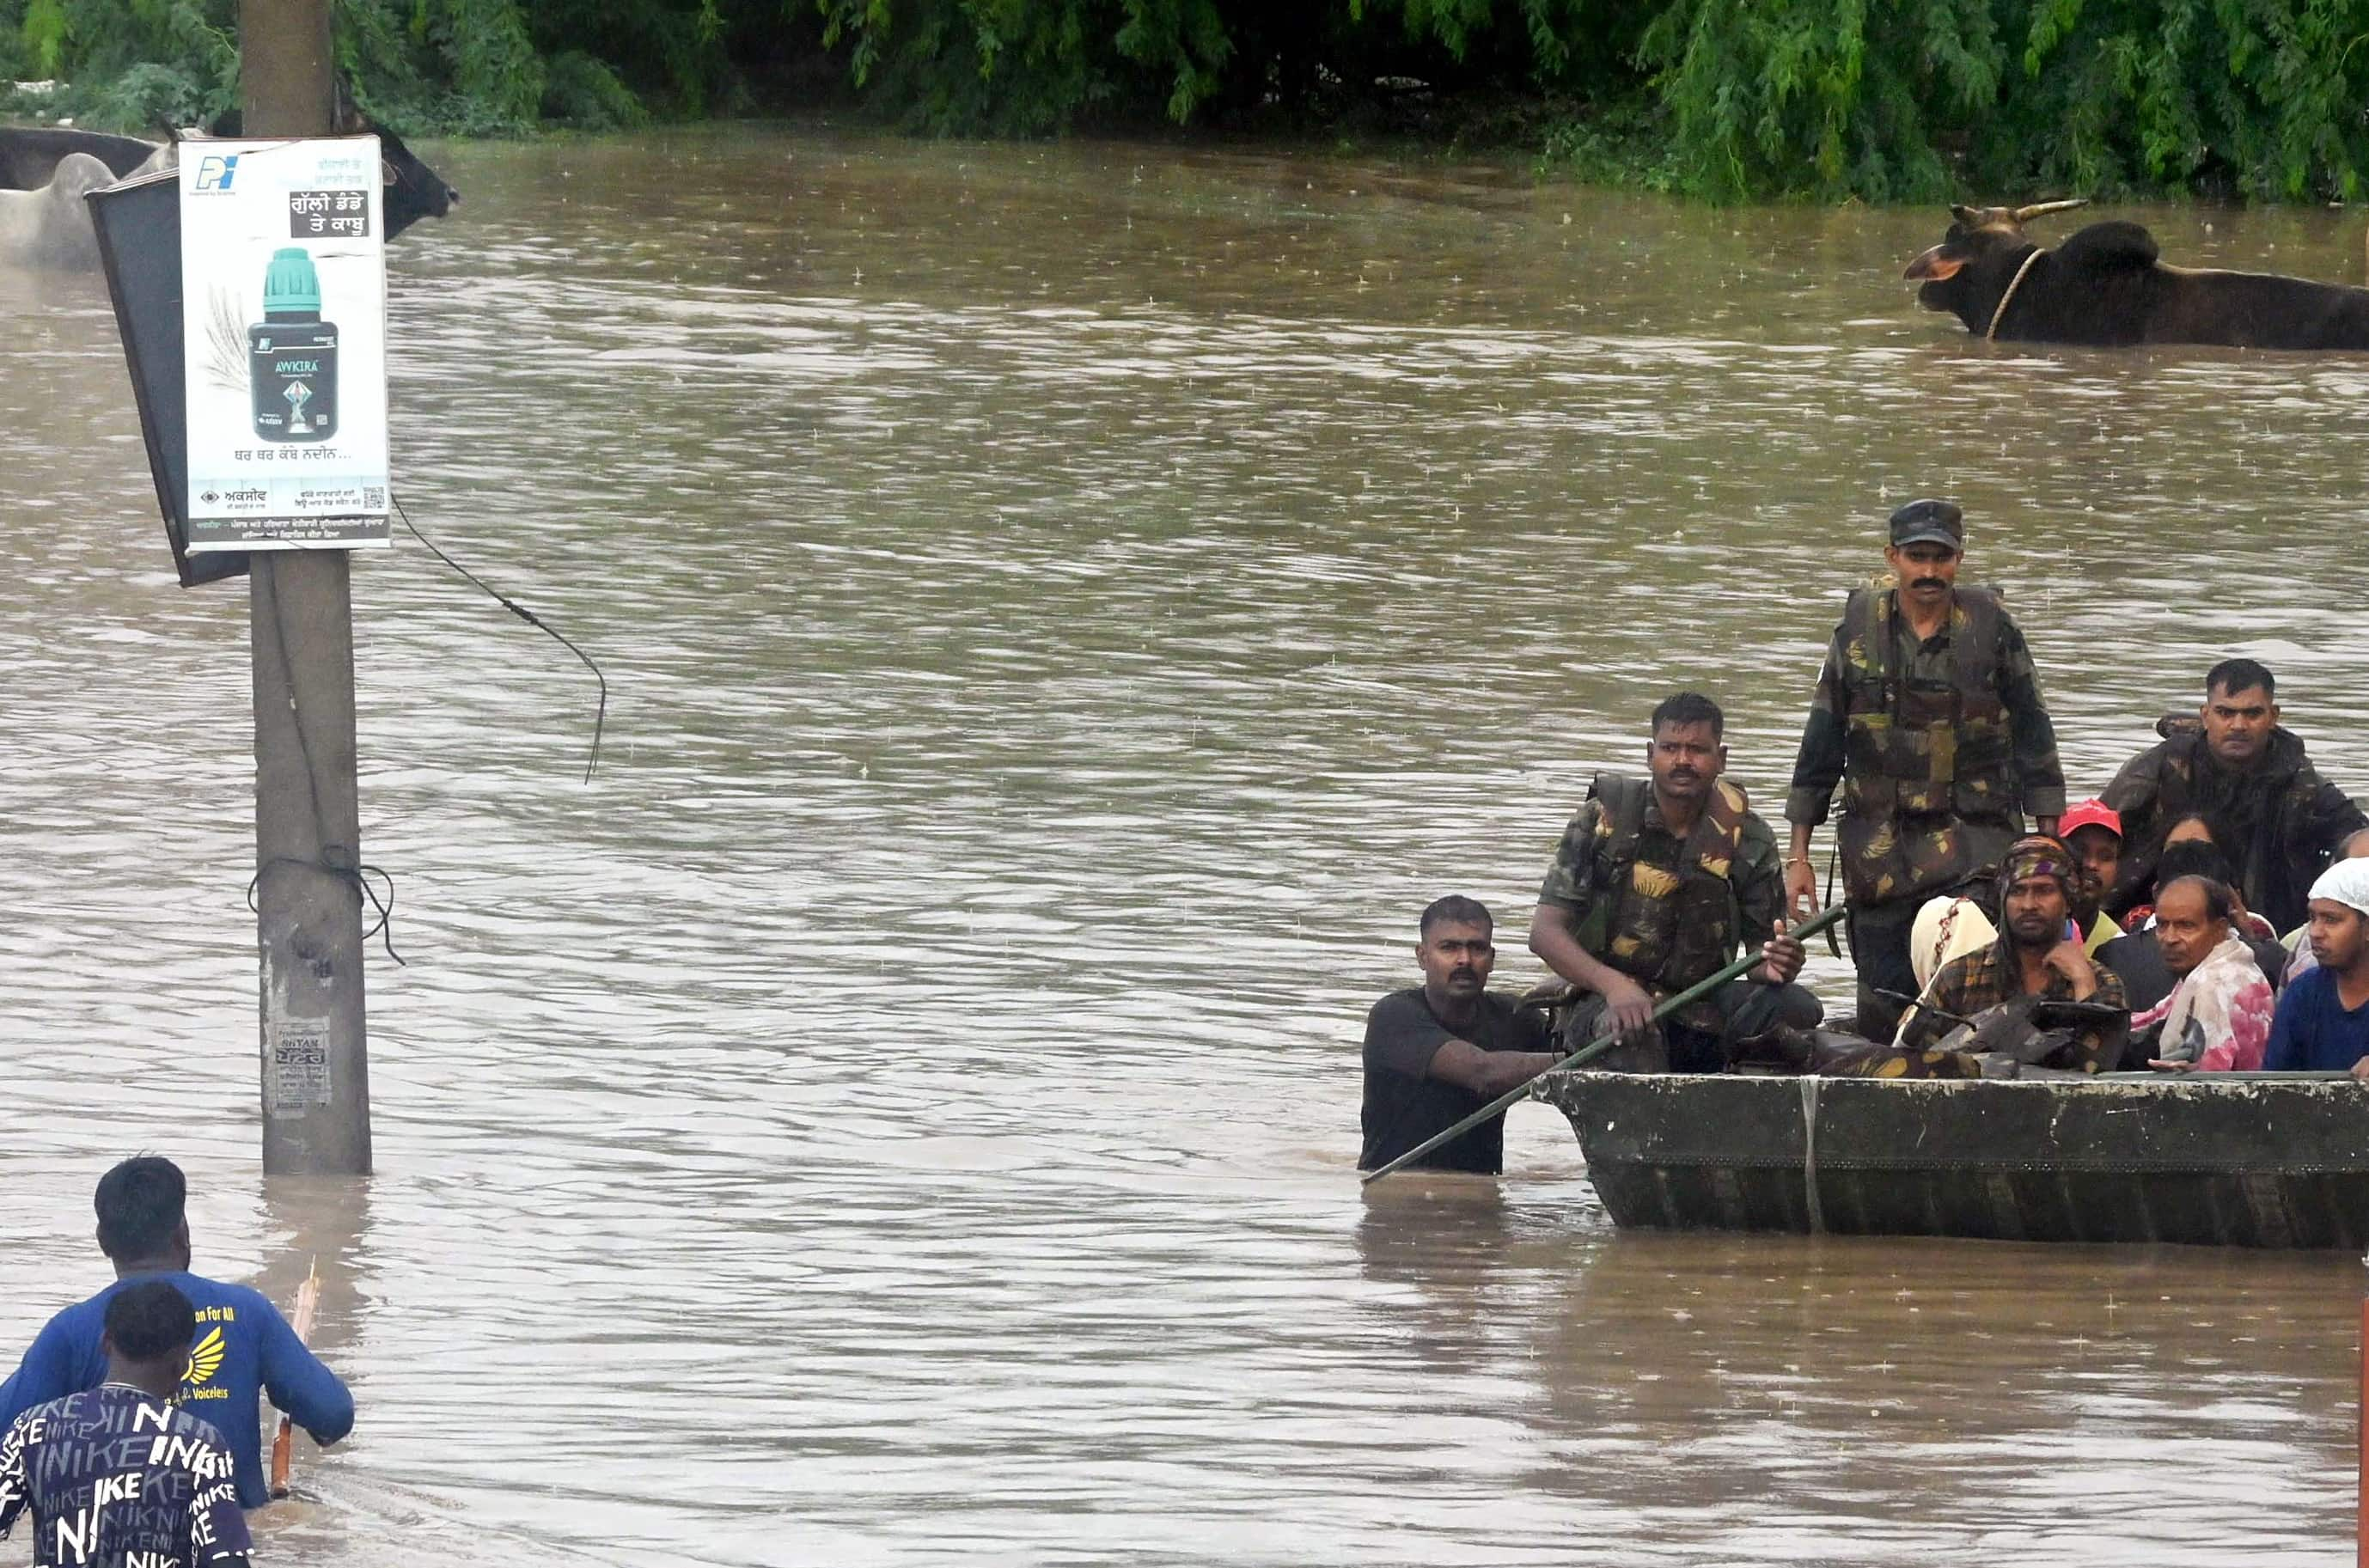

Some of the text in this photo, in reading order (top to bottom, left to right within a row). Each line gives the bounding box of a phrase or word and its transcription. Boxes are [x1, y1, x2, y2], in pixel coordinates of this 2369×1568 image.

[291, 192, 364, 214] ਗੁੱਲੀ ਡੰਡੇ
[309, 213, 365, 236] ਤੇ ਕਾਬੂ
[275, 359, 318, 372] AWKIRA
[206, 1305, 221, 1321] For
[223, 1306, 235, 1321] All
